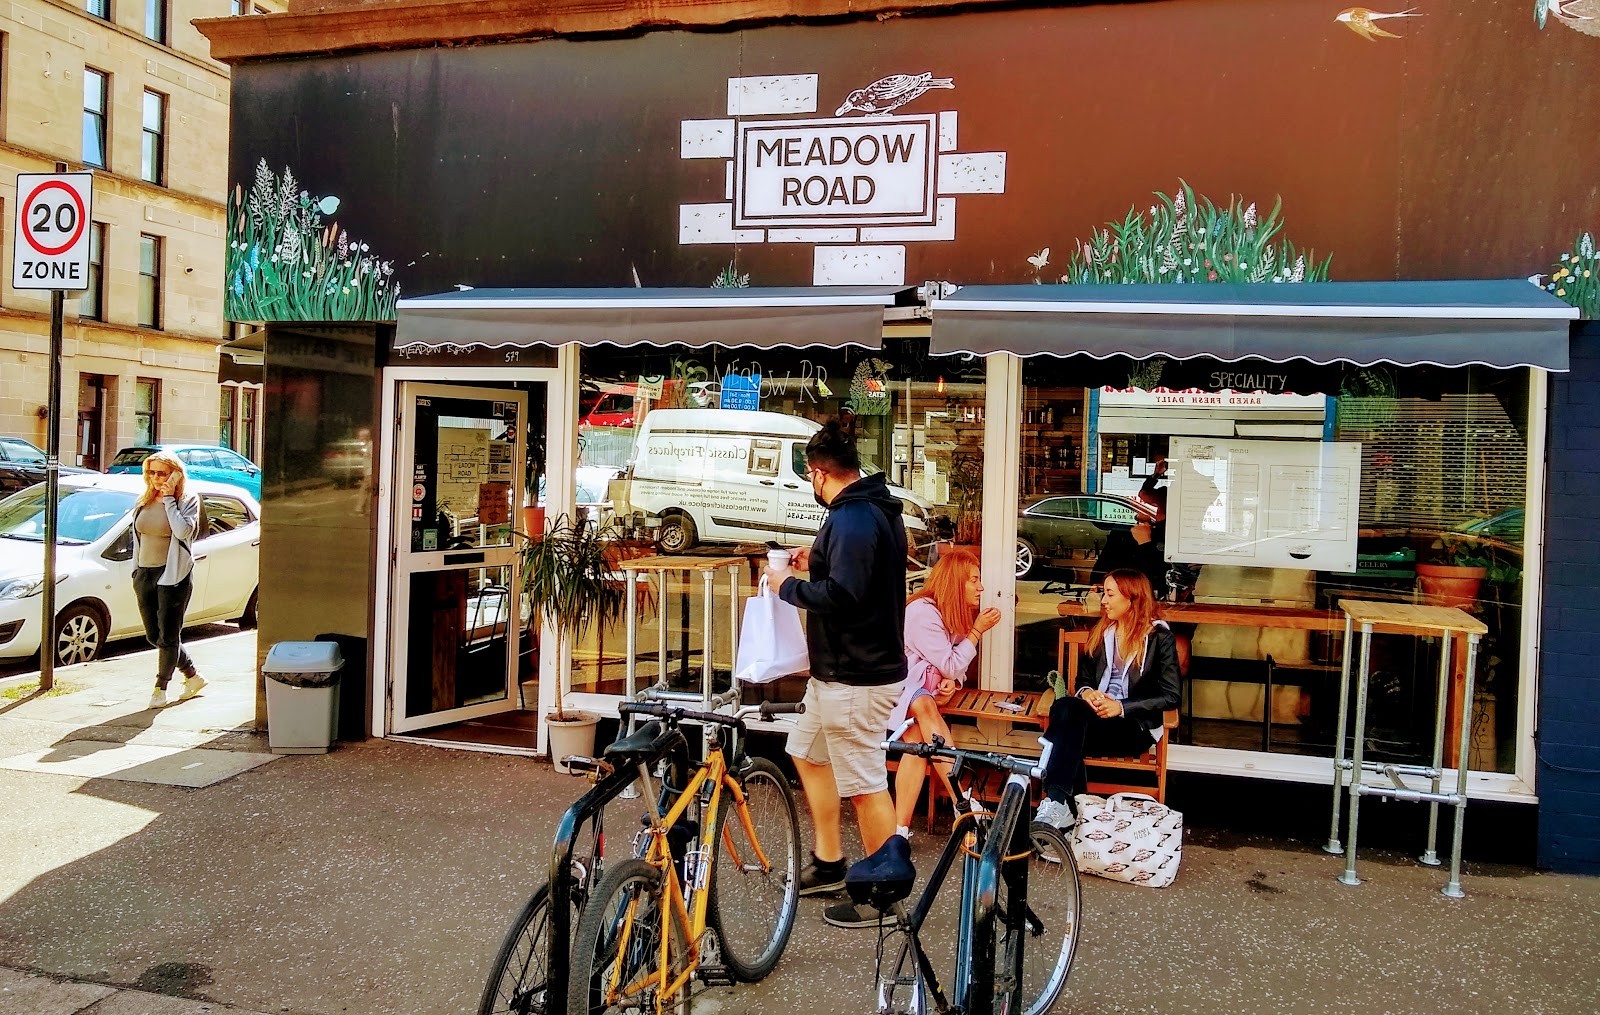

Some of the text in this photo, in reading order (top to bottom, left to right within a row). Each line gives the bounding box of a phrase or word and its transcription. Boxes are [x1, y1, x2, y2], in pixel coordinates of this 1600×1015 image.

[756, 133, 915, 167] MEADOW
[782, 175, 876, 206] ROAD
[32, 203, 76, 233] 20
[22, 261, 80, 280] ZONE
[399, 344, 441, 360] MEADOW
[1209, 372, 1288, 390] SPECIALITY
